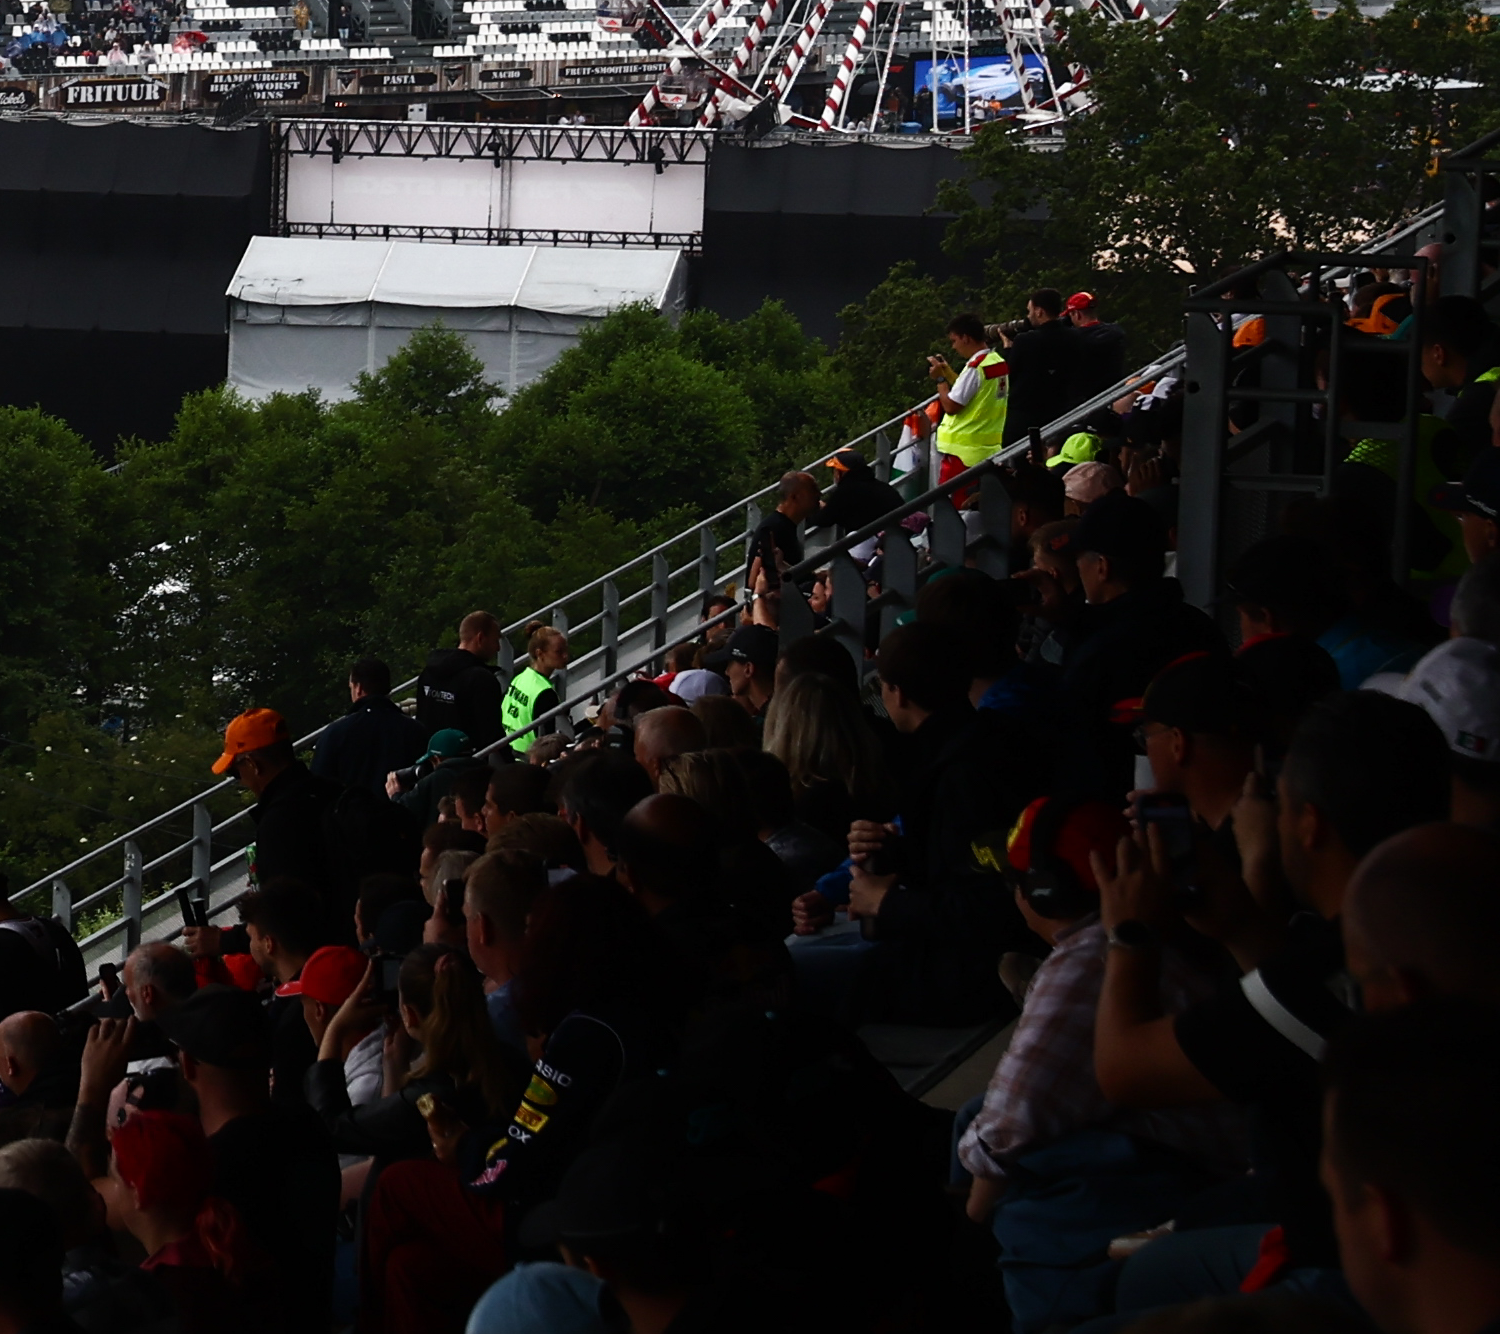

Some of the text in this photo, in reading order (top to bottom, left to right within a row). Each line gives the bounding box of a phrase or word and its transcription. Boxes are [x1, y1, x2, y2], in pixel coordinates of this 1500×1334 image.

[491, 70, 521, 79] NACHO
[383, 75, 416, 85] PASTA
[67, 83, 160, 103] FRITUUR
